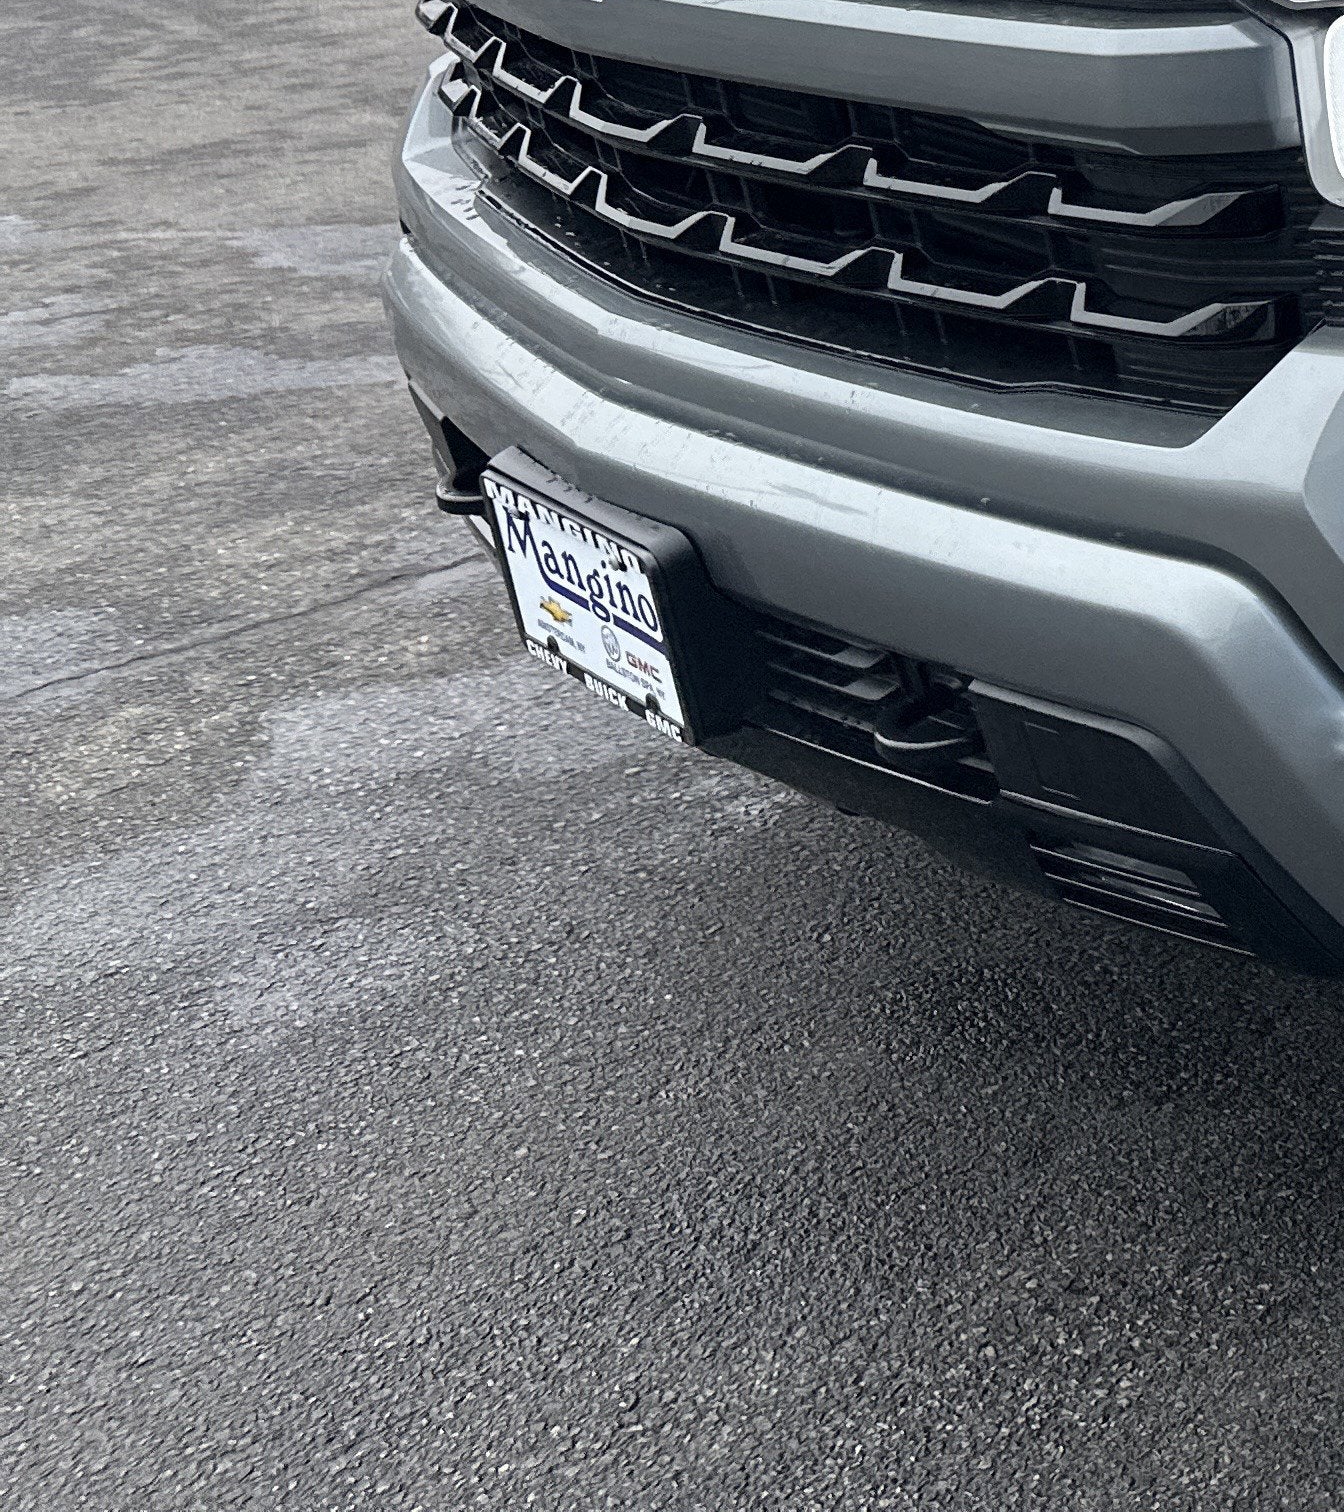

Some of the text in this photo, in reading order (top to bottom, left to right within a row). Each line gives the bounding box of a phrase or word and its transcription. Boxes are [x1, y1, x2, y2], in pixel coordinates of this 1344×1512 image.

[503, 505, 659, 632] Mangino
[525, 639, 568, 675] CHEVY
[584, 672, 630, 712] BUICK
[645, 709, 683, 743] GMC
[625, 651, 663, 684] GMC
